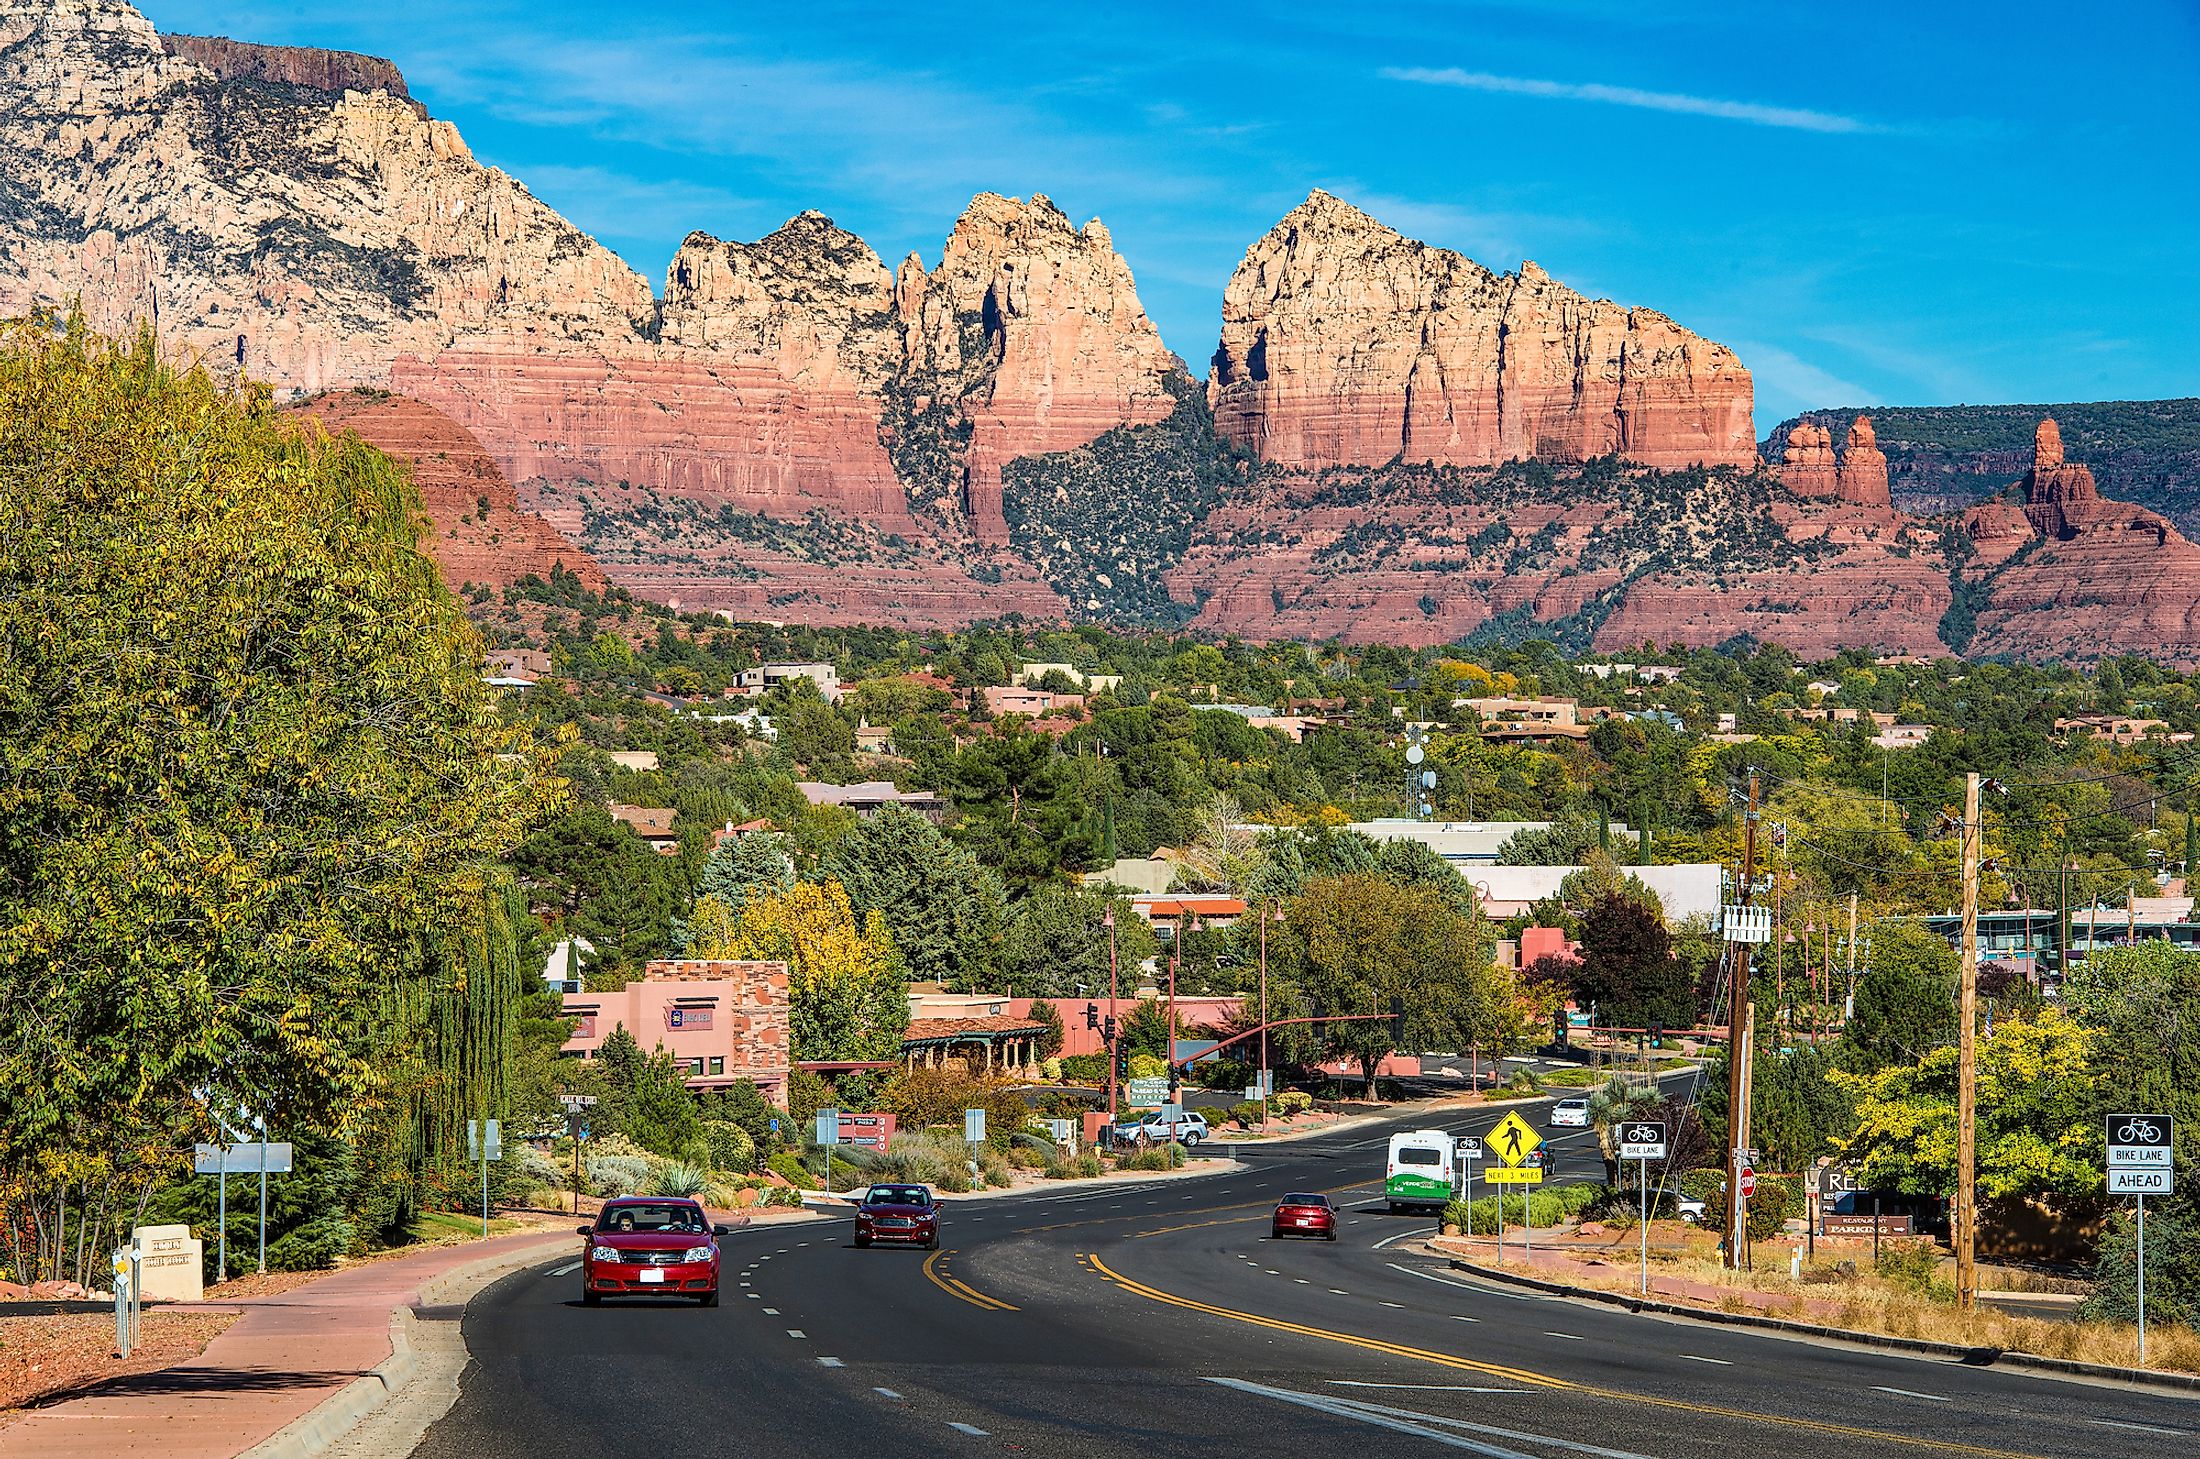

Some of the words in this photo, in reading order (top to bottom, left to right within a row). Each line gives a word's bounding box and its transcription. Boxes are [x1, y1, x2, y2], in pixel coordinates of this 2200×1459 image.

[1626, 1146, 1641, 1154] BIKE
[1643, 1146, 1659, 1154] LANE
[2116, 1150, 2136, 1160] BIKE
[2140, 1150, 2163, 1160] LANE
[1741, 1176, 1755, 1189] STOP
[2117, 1175, 2163, 1187] AHEAD
[1830, 1226, 1888, 1234] PARKING
